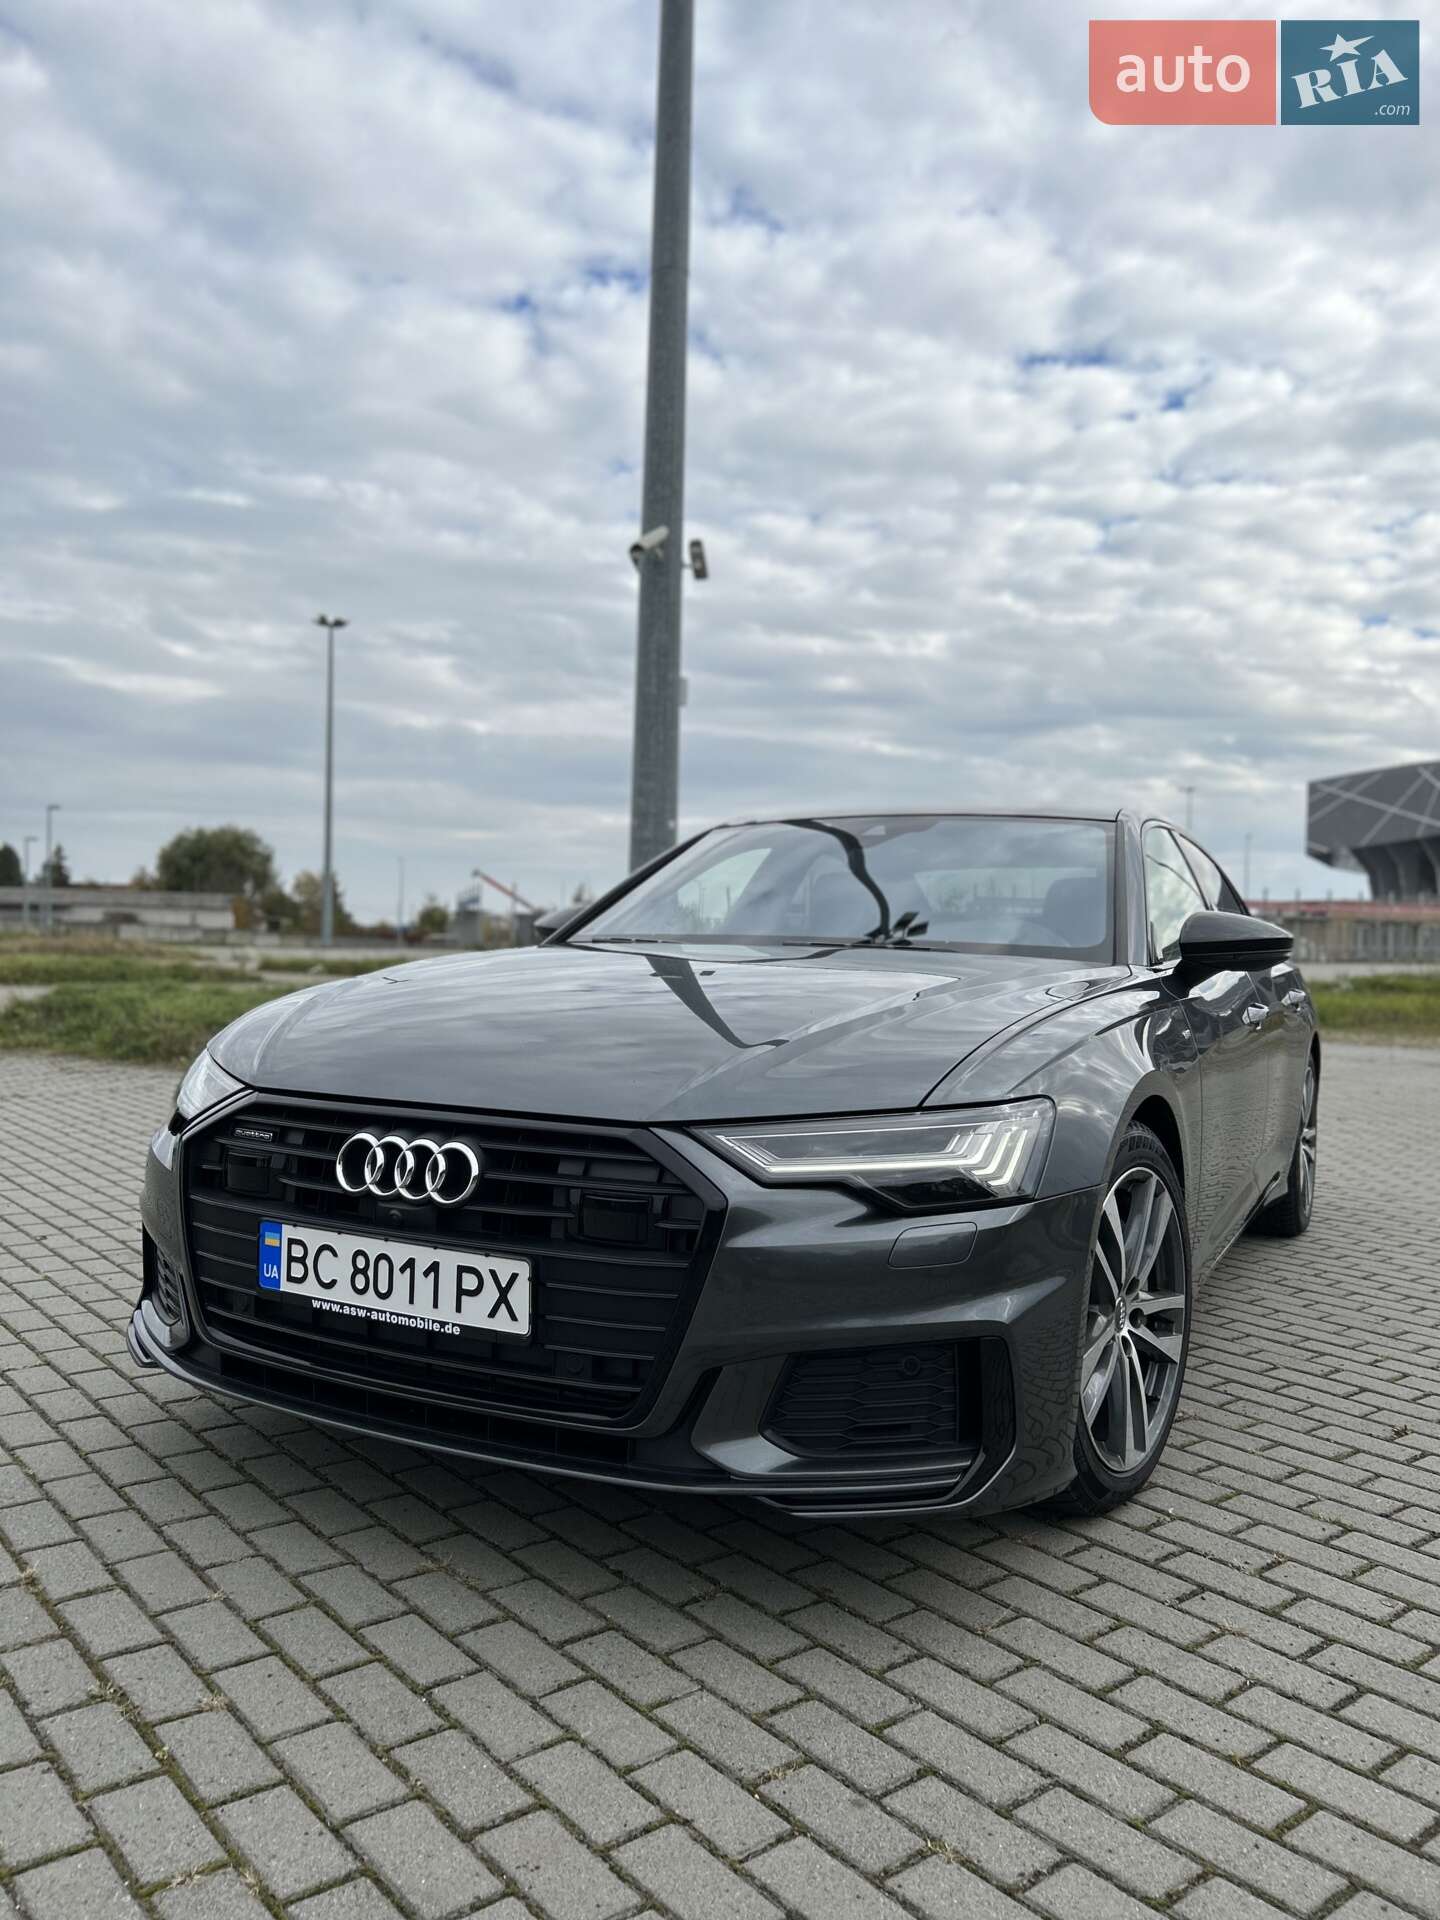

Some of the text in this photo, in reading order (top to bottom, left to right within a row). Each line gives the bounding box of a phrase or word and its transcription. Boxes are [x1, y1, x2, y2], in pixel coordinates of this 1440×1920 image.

[263, 1263, 279, 1280] UA
[286, 1237, 519, 1322] BC 8011 PX
[311, 1299, 461, 1335] www.asw-automobile.de
